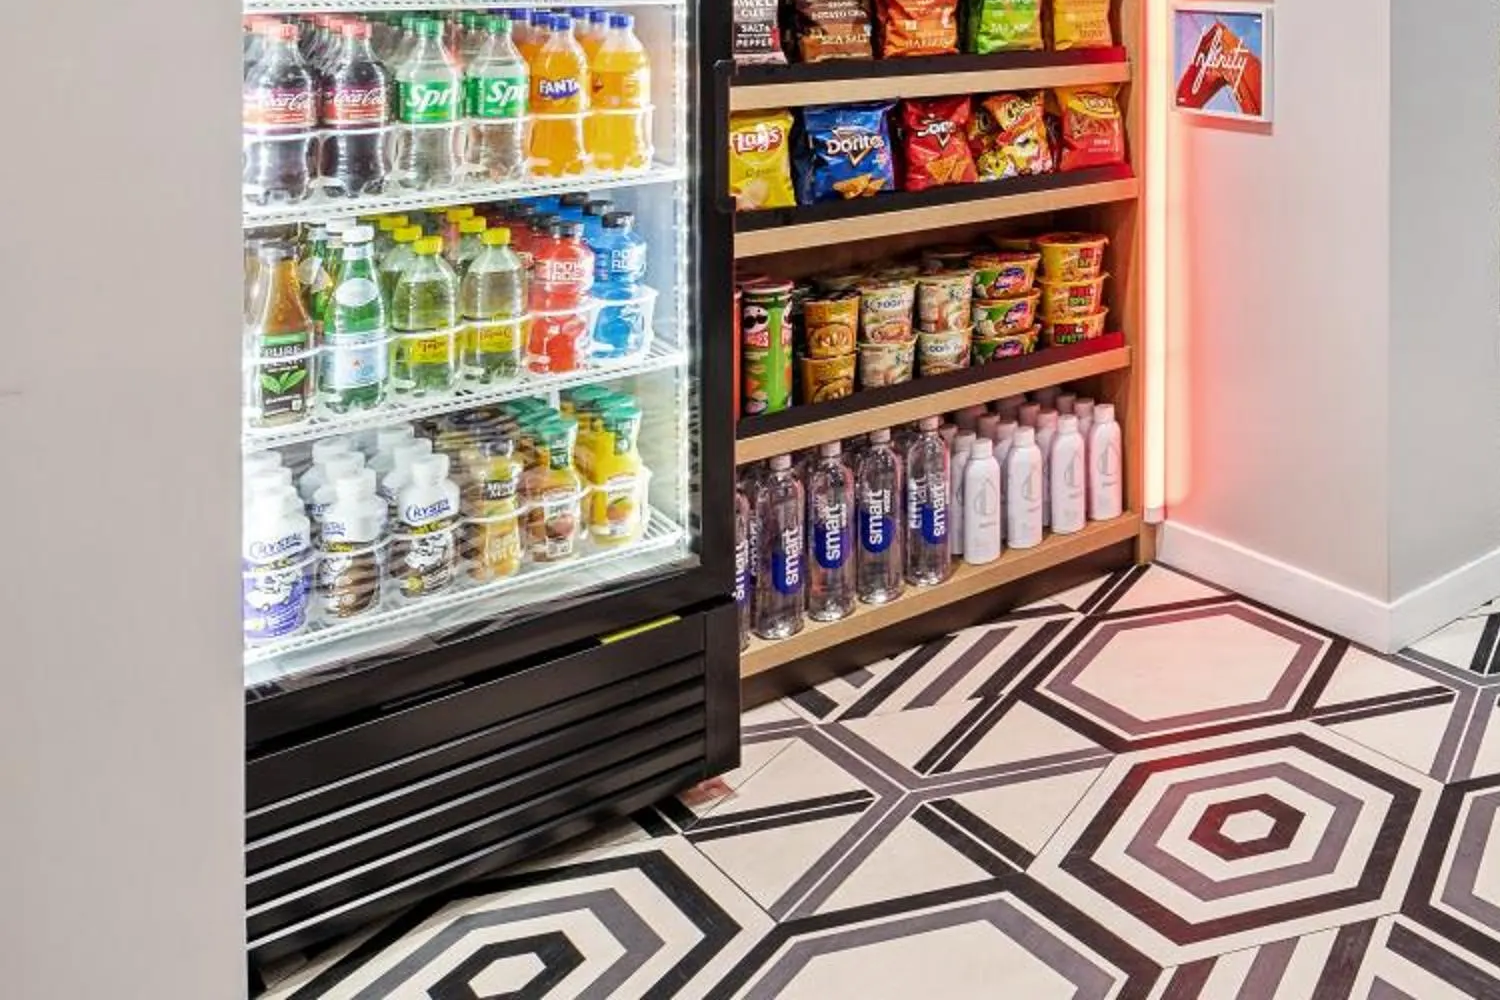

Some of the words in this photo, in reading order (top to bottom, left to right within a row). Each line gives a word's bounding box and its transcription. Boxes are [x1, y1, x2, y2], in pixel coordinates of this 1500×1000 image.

[1191, 25, 1249, 95] Infinity
[825, 133, 885, 155] Doritos
[825, 503, 840, 560] smart
[868, 489, 883, 545] smart
